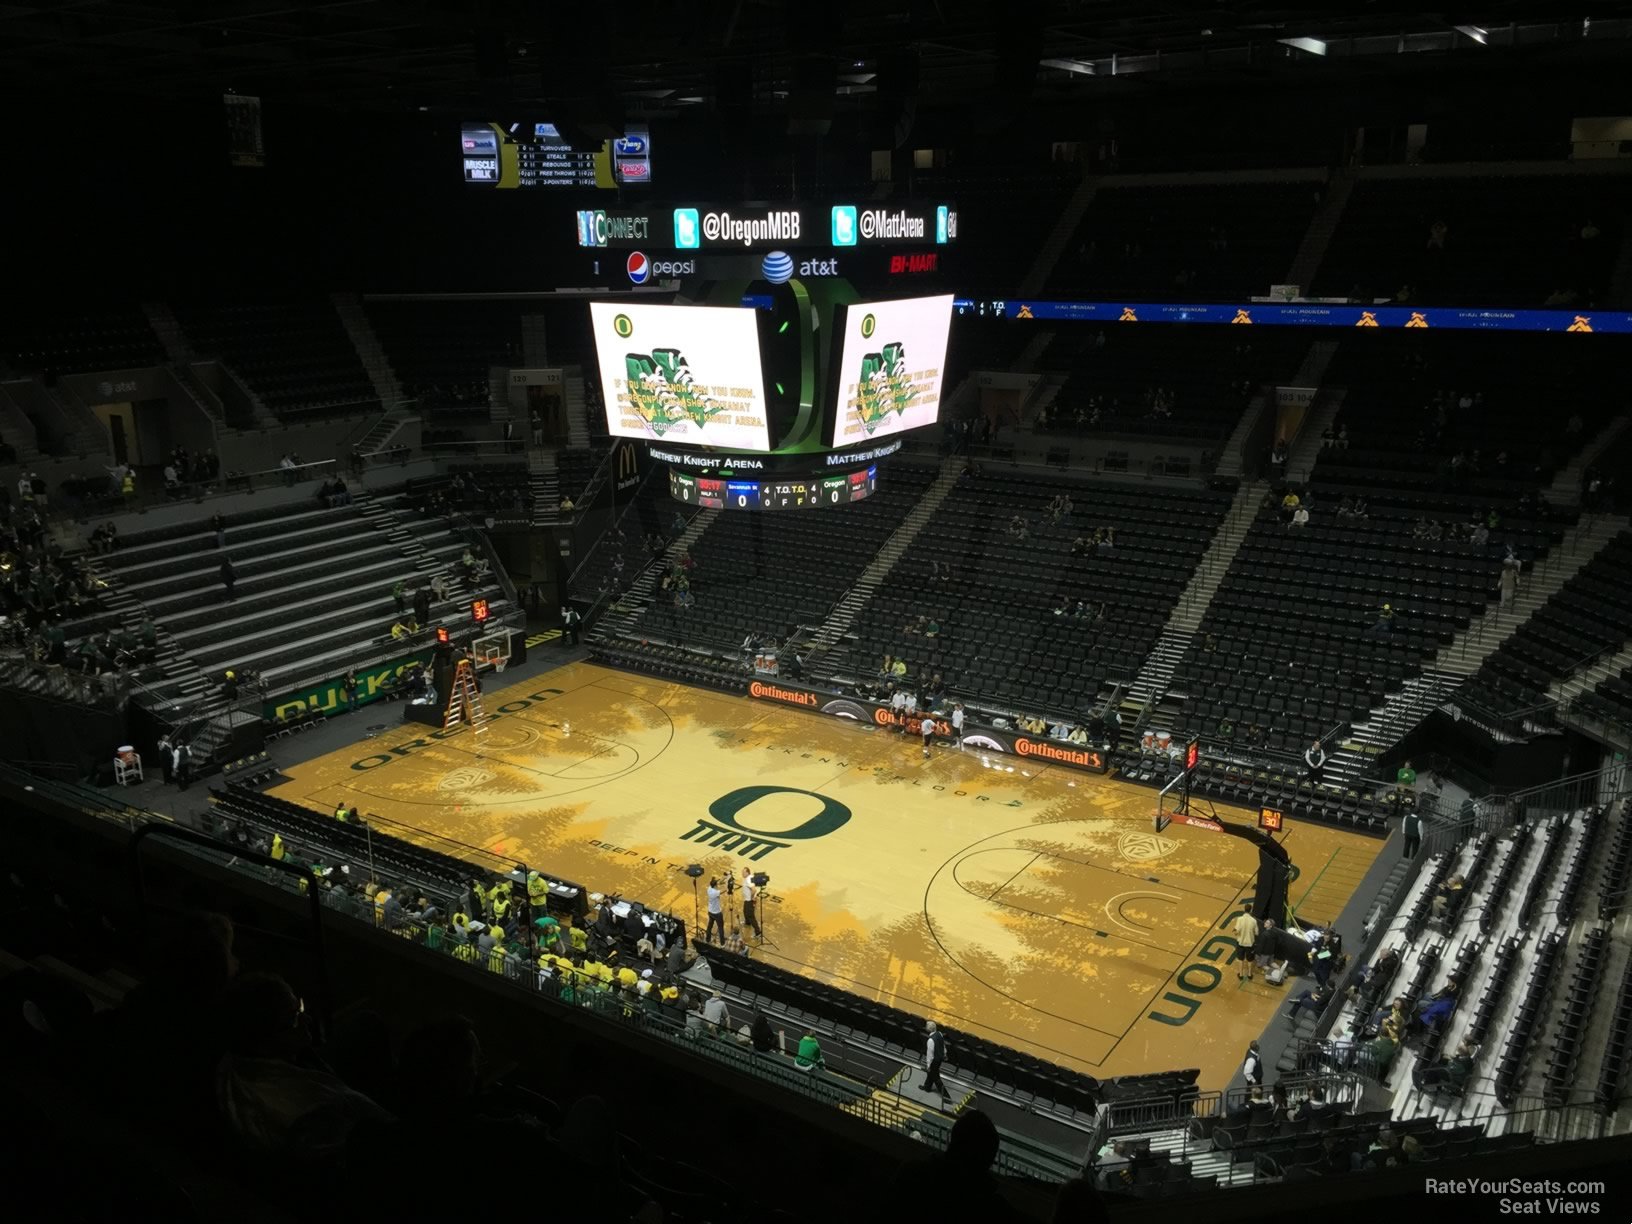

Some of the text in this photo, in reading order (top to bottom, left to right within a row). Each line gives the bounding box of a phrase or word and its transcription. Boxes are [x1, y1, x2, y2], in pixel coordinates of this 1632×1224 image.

[465, 160, 495, 170] MUSCLE
[471, 169, 491, 179] MILK
[595, 213, 648, 244] CONNECT
[703, 211, 800, 247] @OregonMBB
[860, 209, 924, 239] @MattArena
[652, 260, 695, 277] pepsi
[800, 257, 838, 276] at&t
[650, 448, 763, 469] MATTHEW KNIGHT ARENA
[826, 451, 874, 466] MATTHEW
[678, 477, 694, 487] Oregon
[811, 484, 816, 492] 4
[823, 479, 846, 488] Oregon
[683, 488, 689, 500] 0
[775, 486, 791, 494] T.O.
[791, 485, 807, 493] T.O.
[738, 495, 747, 507] 0
[782, 498, 788, 506] F
[797, 497, 803, 505] F
[831, 490, 839, 503] 0
[764, 499, 770, 507] 0
[475, 606, 487, 619] 30
[750, 681, 809, 705] Continental
[1015, 738, 1089, 765] Continental
[1265, 817, 1276, 827] 30
[588, 838, 638, 857] DEEP
[641, 855, 661, 865] IN
